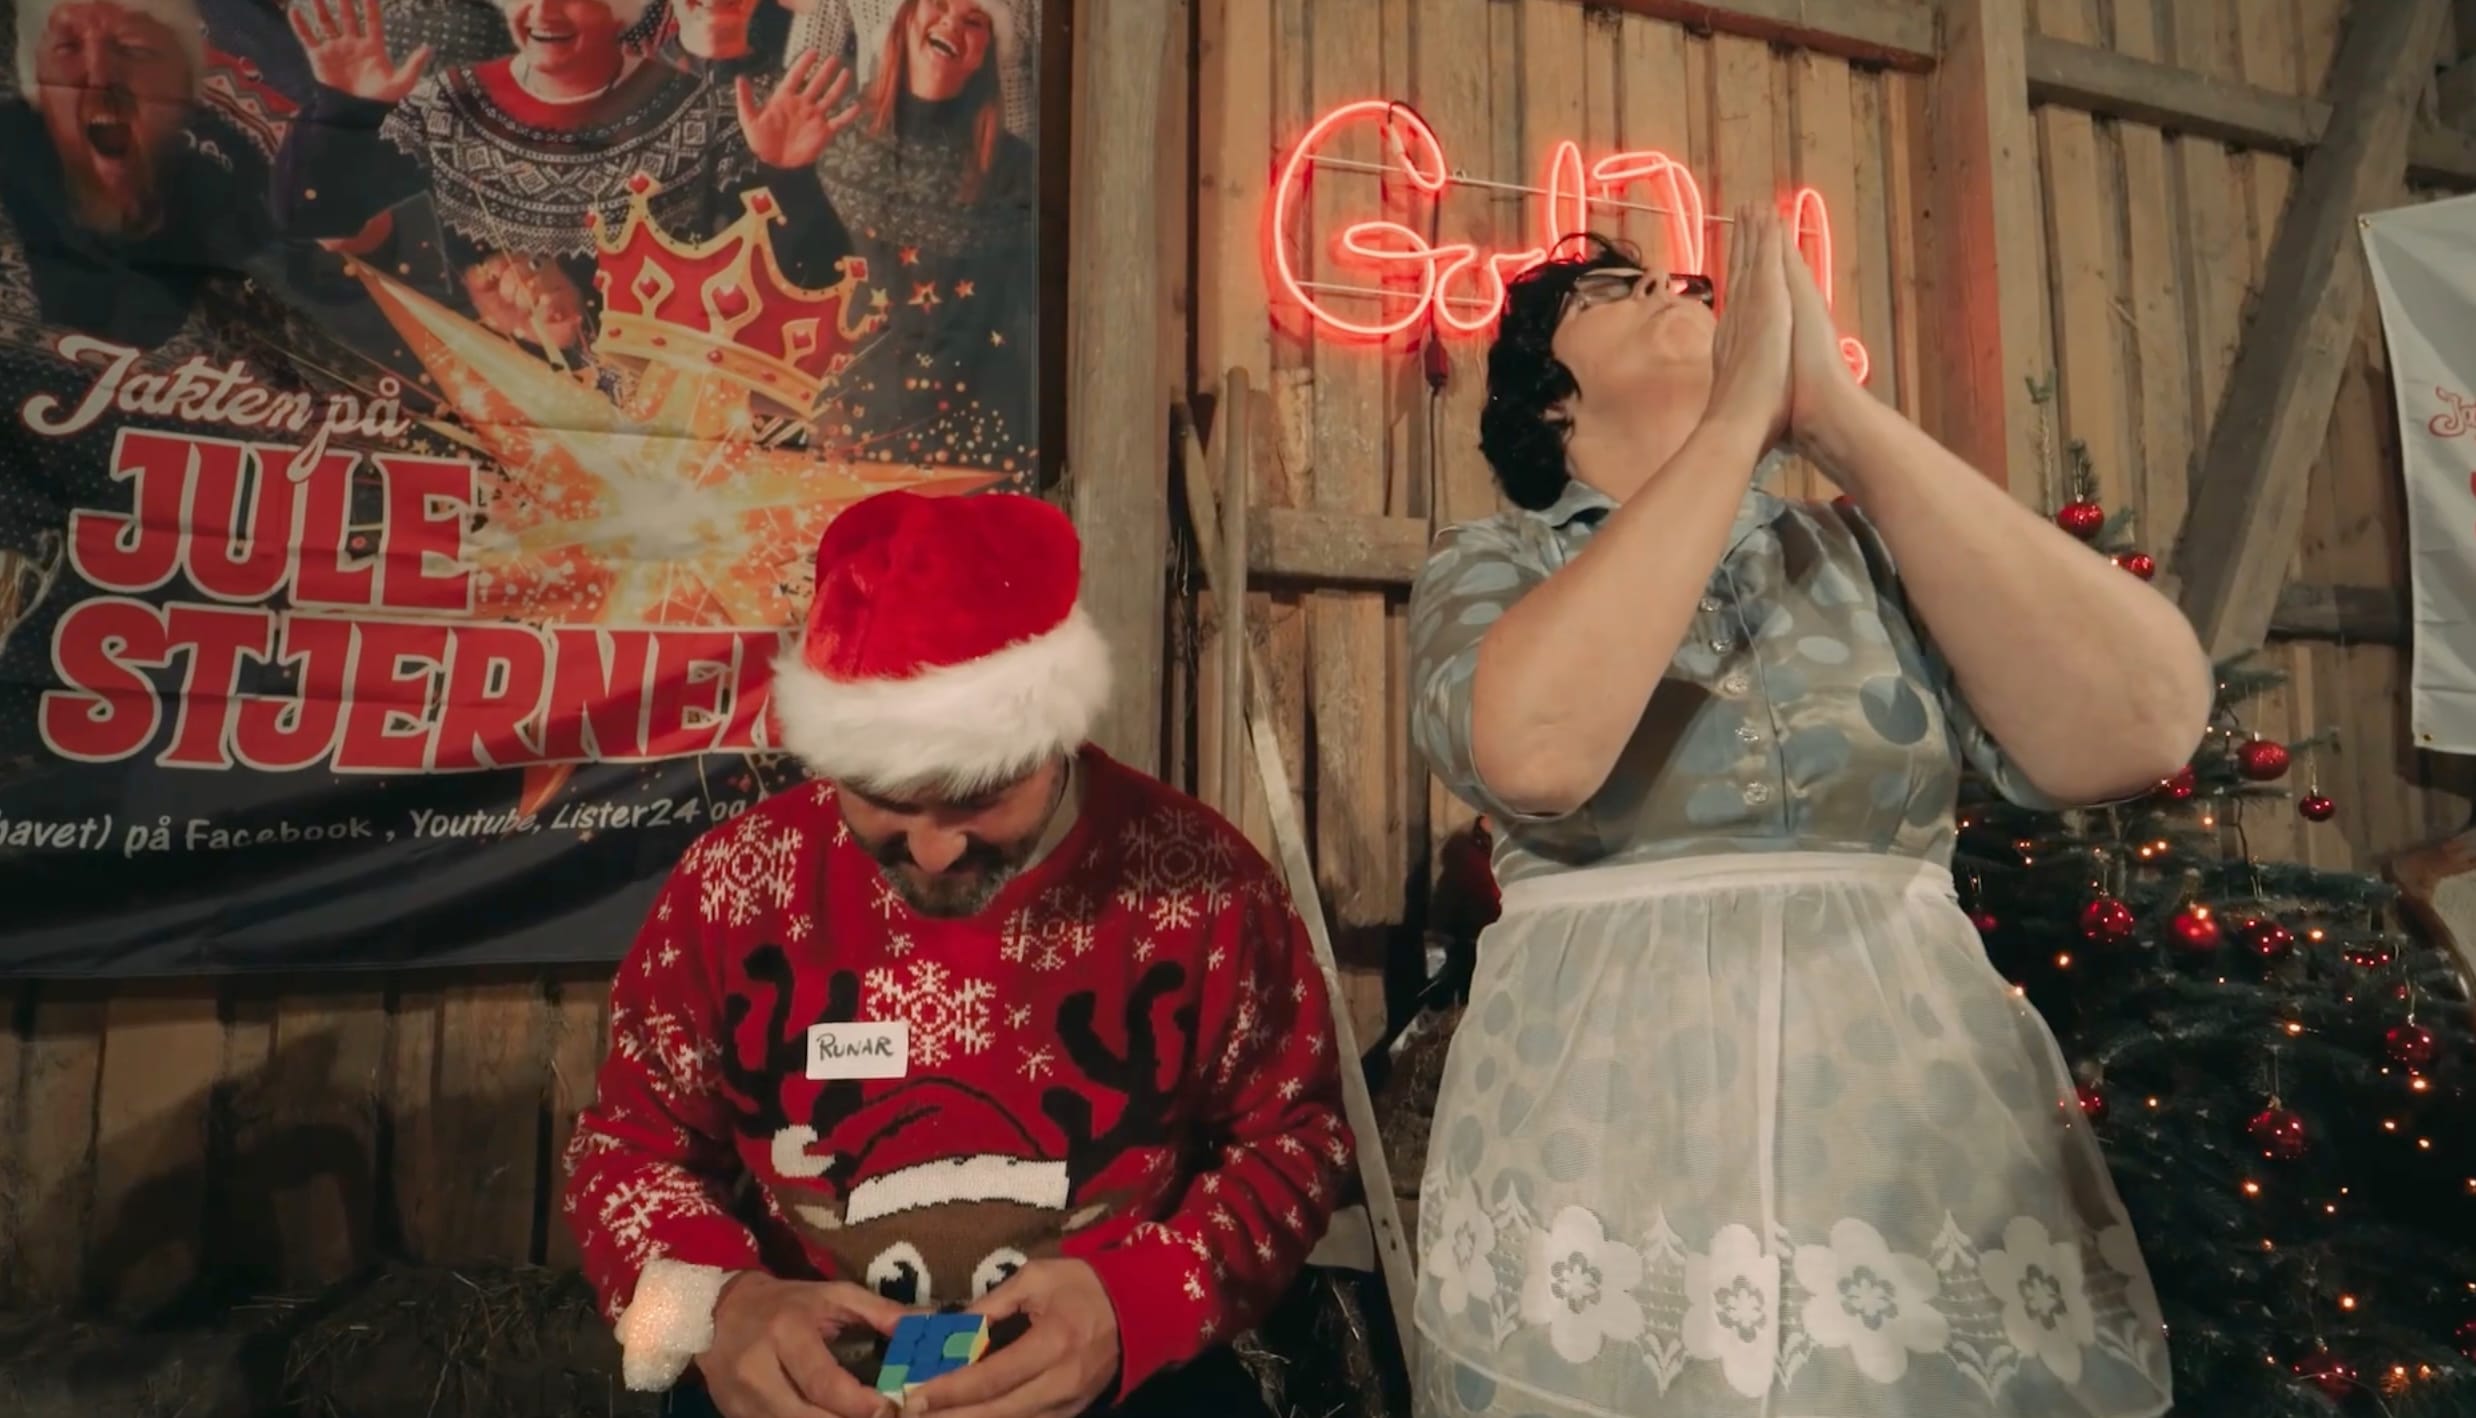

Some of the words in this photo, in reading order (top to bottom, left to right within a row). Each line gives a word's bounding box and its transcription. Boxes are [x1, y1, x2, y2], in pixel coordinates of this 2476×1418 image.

[21, 333, 313, 436] Jakten
[287, 377, 412, 482] på
[67, 426, 481, 615] JULE
[124, 815, 171, 858] på
[185, 817, 373, 851] Facebook
[409, 807, 542, 838] Youtube,
[551, 797, 701, 830] Lister24
[816, 1033, 894, 1061] RUNAR
